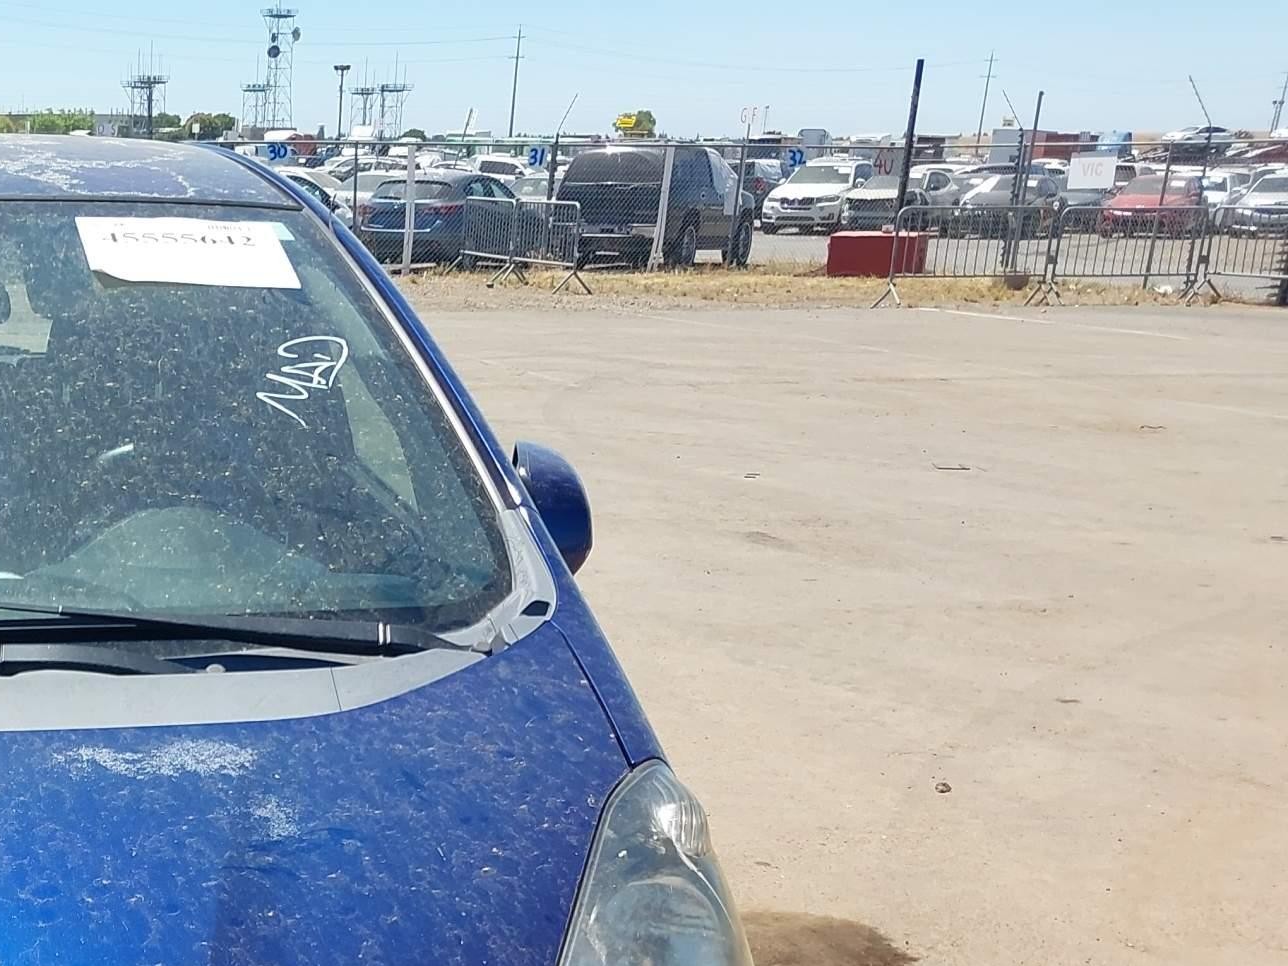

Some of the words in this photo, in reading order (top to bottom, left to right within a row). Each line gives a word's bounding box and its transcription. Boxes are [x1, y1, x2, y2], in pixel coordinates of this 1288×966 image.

[267, 144, 288, 160] 30
[529, 148, 545, 166] 31
[788, 149, 806, 167] 32
[1082, 162, 1104, 176] VIC
